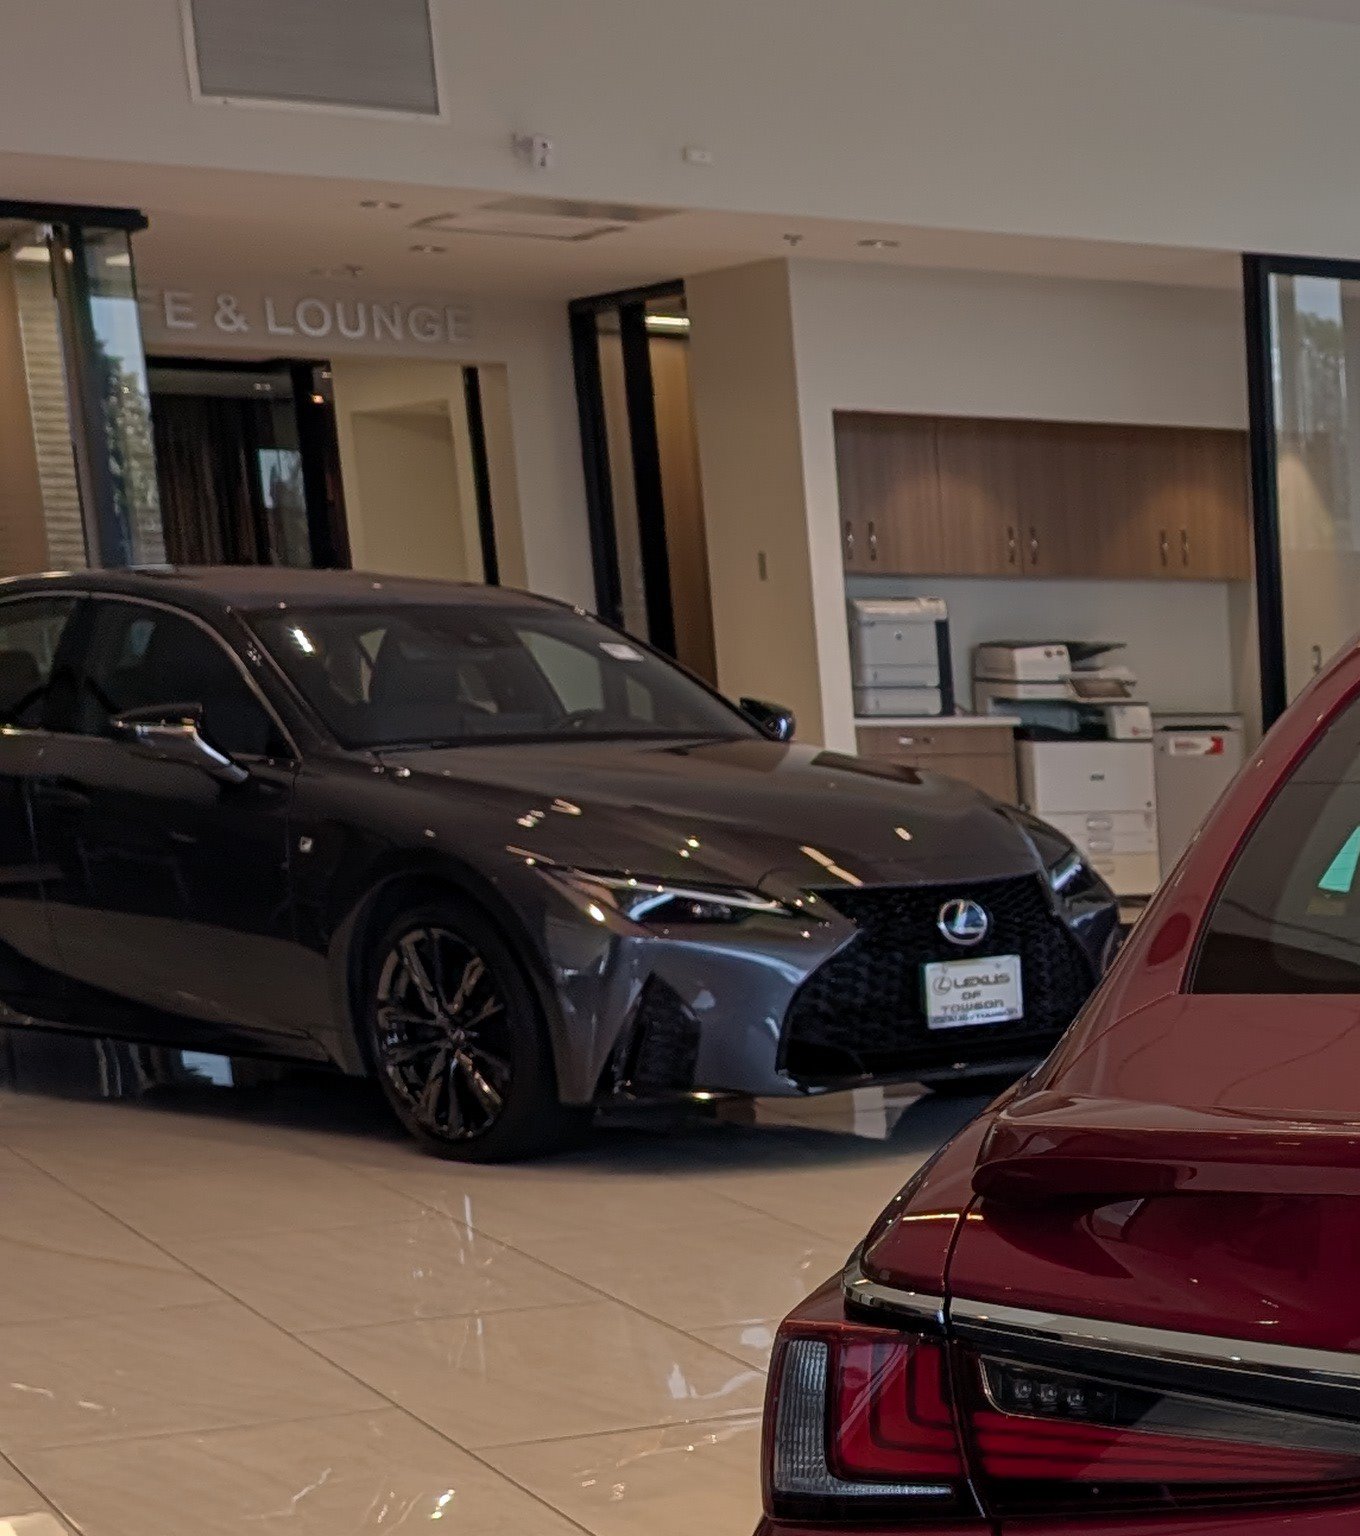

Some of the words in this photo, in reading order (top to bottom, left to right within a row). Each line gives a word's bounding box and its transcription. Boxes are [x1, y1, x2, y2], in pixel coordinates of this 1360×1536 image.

[213, 293, 249, 332] &
[264, 297, 472, 343] LOUNGE
[954, 974, 1010, 988] LEXUS
[962, 991, 981, 1000] OF
